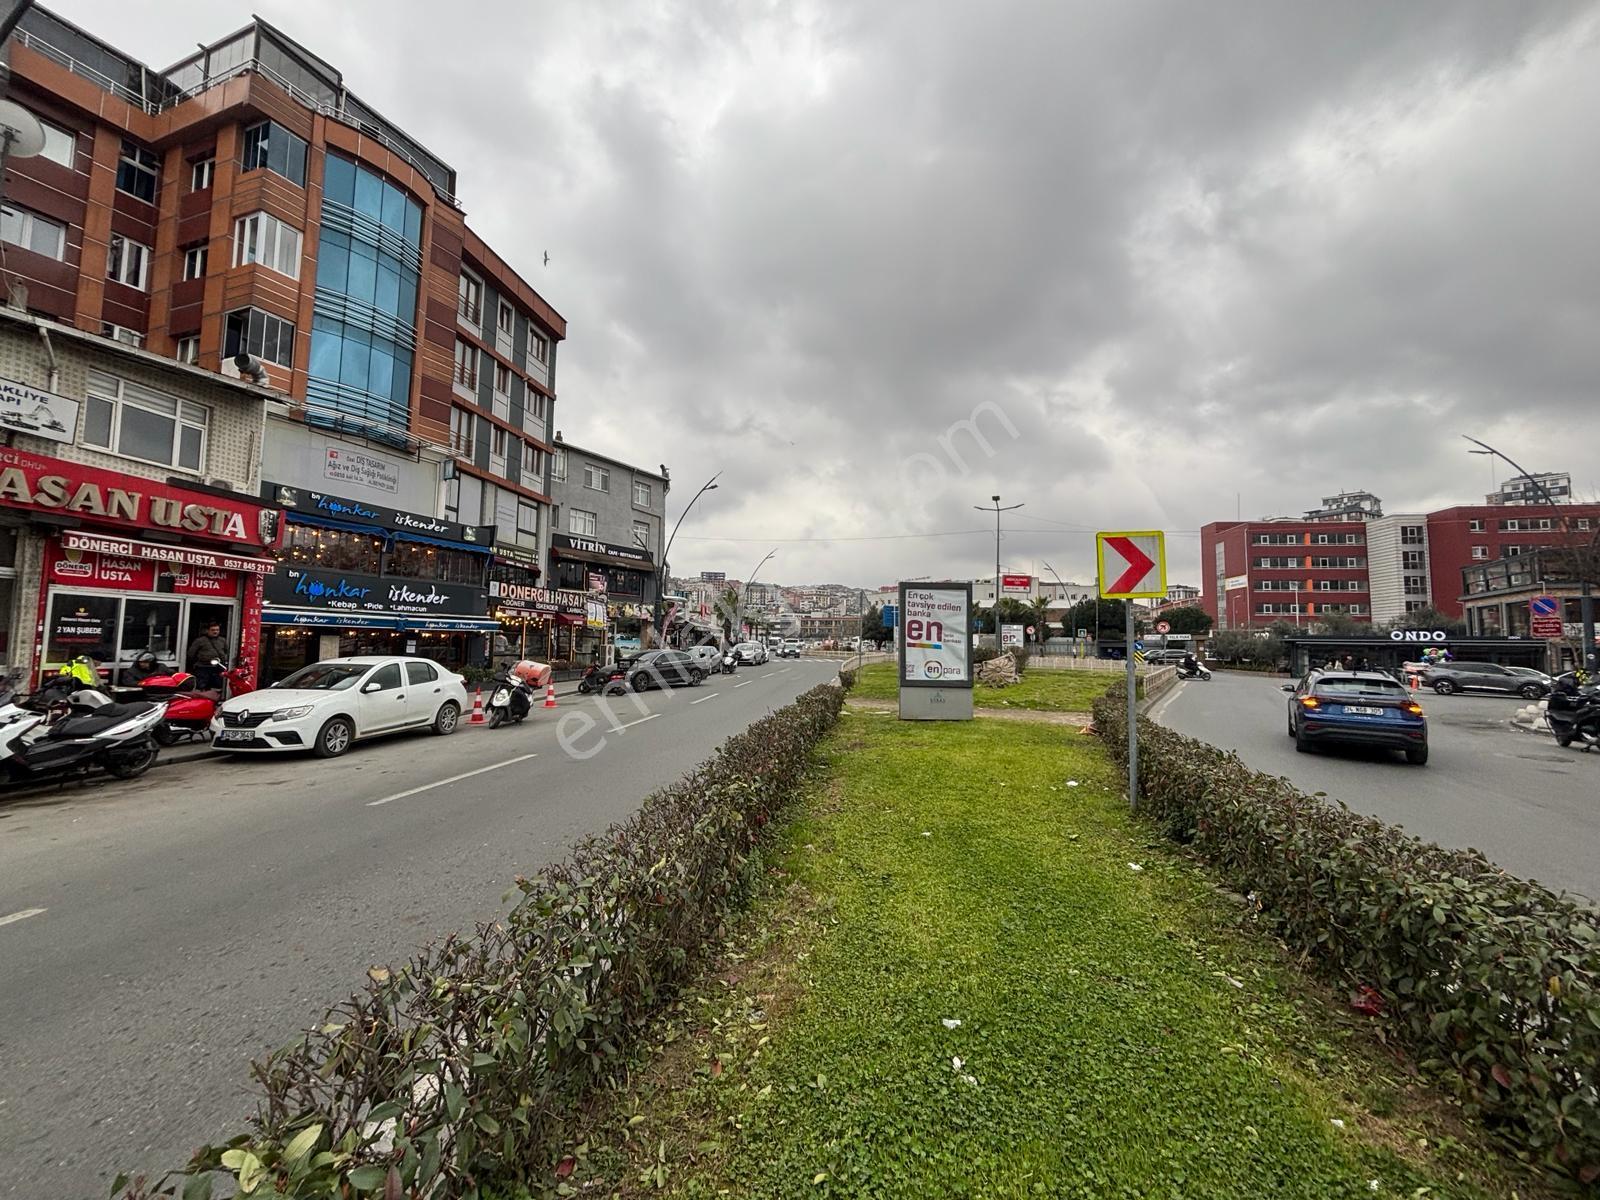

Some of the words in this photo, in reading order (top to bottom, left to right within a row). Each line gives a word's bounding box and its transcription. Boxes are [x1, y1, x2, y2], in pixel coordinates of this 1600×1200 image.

[149, 495, 247, 539] USTA
[394, 513, 449, 533] iskender
[569, 538, 606, 554] VİTRİN
[69, 536, 133, 555] DÖNERCİ
[141, 547, 184, 562] HASAN
[187, 553, 217, 566] USTA
[224, 558, 241, 569] 0537
[243, 560, 256, 571] 845
[257, 562, 266, 572] 21
[266, 563, 275, 573] 71
[499, 548, 514, 558] USTA
[56, 561, 91, 571] DÖNERCİ
[101, 558, 142, 572] HASAN
[101, 570, 132, 582] USTA
[196, 569, 227, 580] HASAN
[196, 579, 220, 589] USTA
[288, 570, 299, 578] bn
[388, 584, 450, 605] iskender
[907, 591, 918, 599] En
[919, 592, 934, 600] çok
[331, 600, 357, 609] Kebap
[393, 604, 427, 613] Lahmacun
[907, 600, 936, 610] tavsiye
[937, 602, 961, 612] edilen
[907, 608, 931, 618] banka
[76, 627, 102, 635] ŞUBEDE
[906, 619, 943, 642] en
[1391, 630, 1446, 641] ONDO
